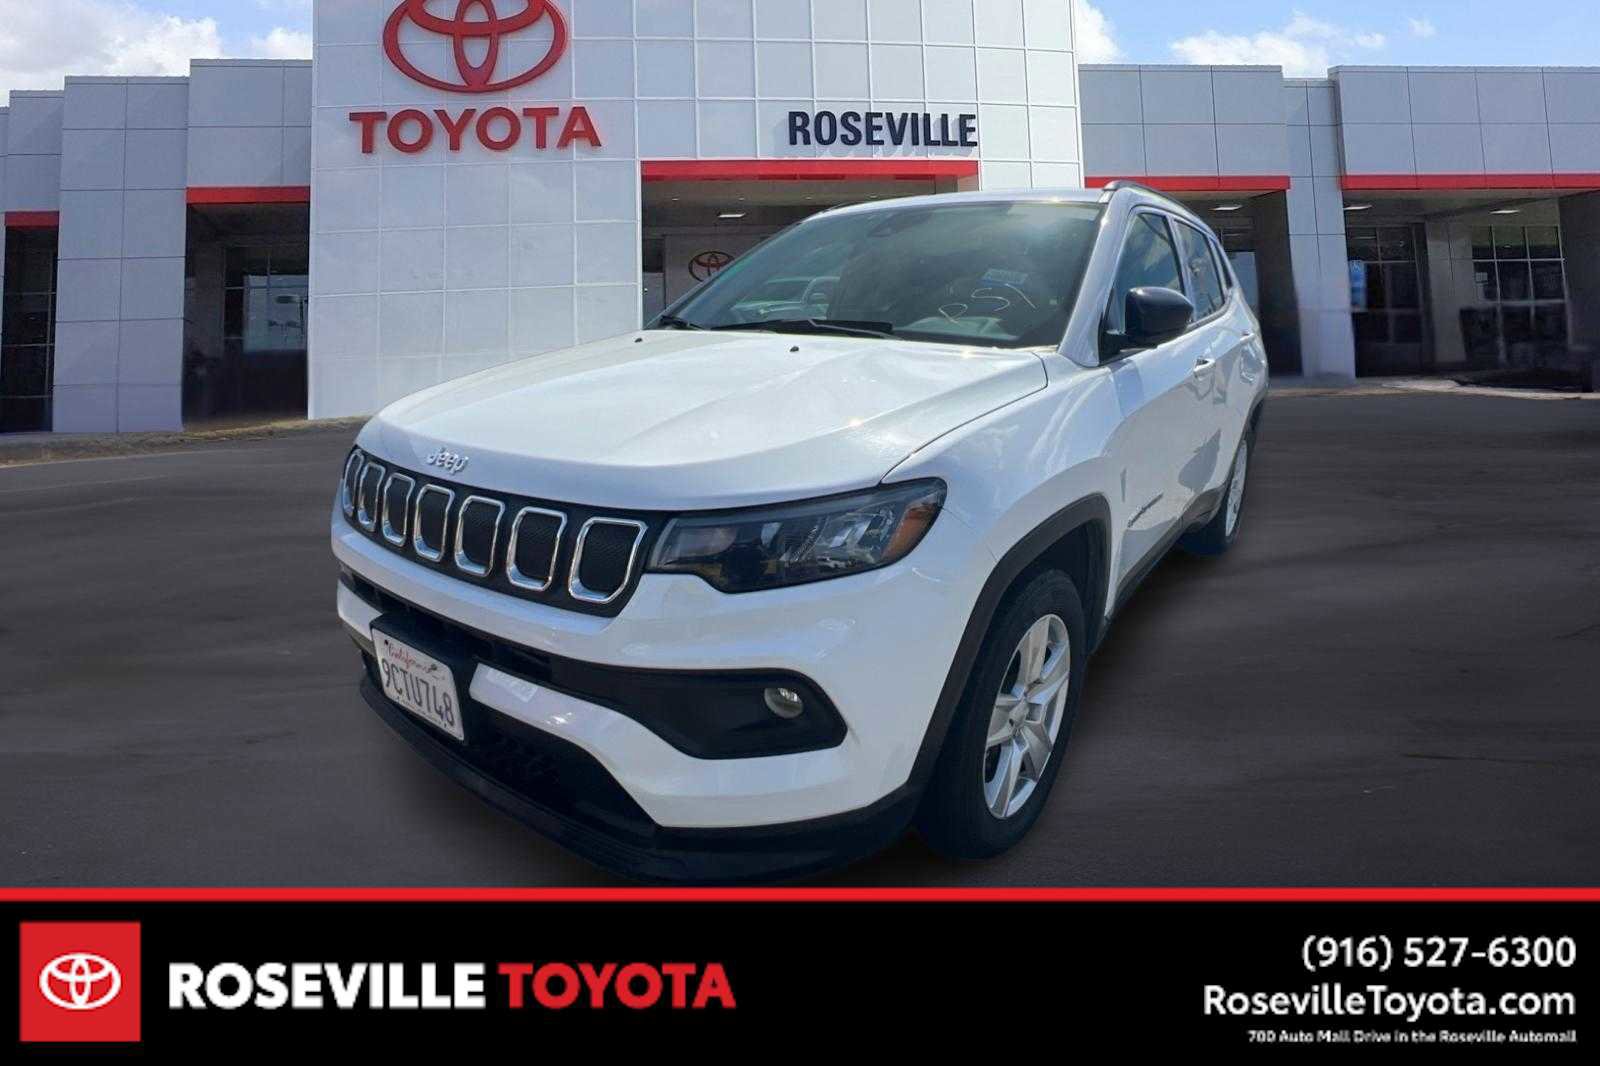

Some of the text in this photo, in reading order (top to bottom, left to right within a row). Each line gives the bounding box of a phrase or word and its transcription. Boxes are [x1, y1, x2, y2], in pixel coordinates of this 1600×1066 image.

[349, 106, 602, 154] TOYOTA
[788, 110, 978, 147] ROSEVILLE
[427, 447, 469, 475] Jeep
[382, 658, 455, 727] 9CTU748
